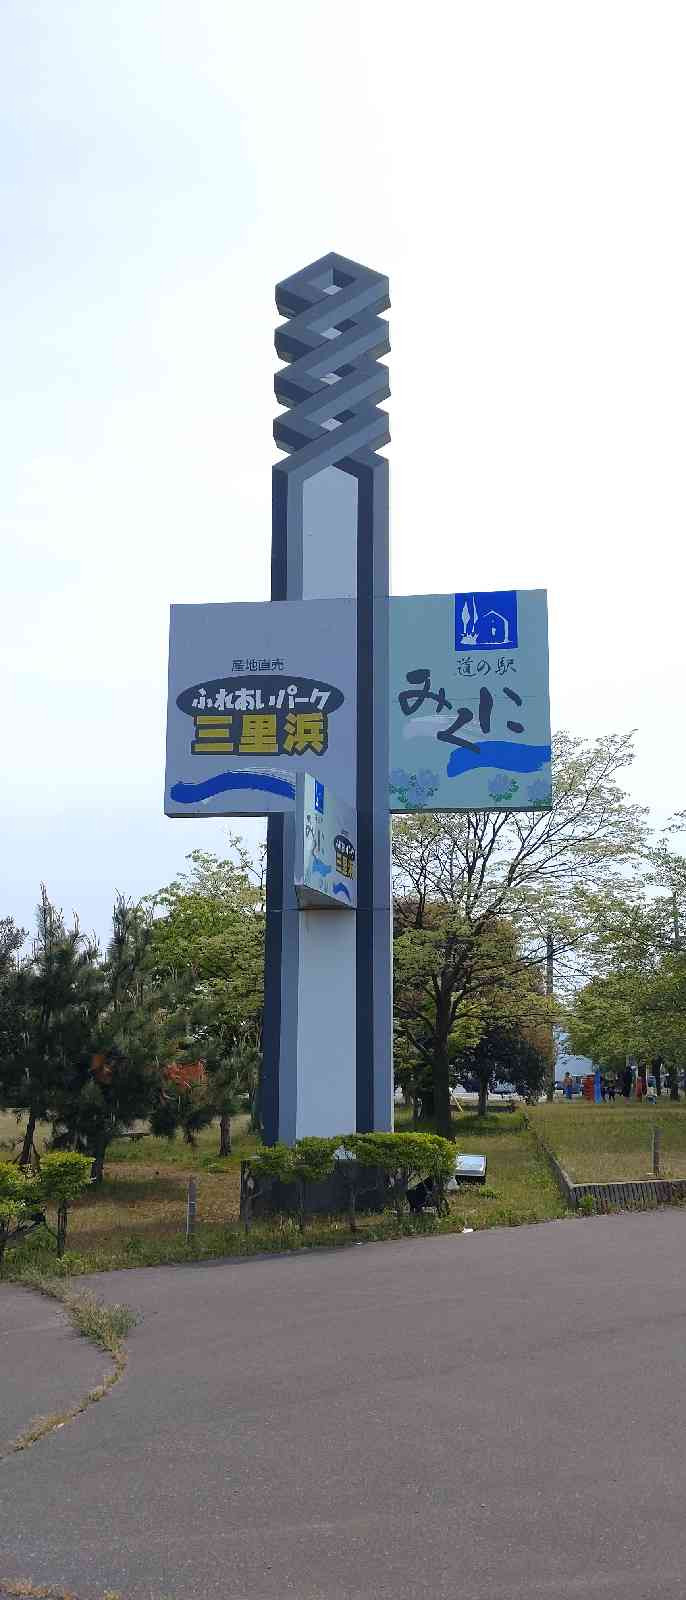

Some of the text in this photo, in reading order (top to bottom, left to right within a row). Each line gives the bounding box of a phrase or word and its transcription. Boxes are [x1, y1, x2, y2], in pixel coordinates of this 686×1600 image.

[231, 657, 285, 672] 産地直売
[456, 656, 517, 677] 道の駅
[191, 684, 332, 711] ふれあいパーク
[398, 668, 525, 755] みくに
[194, 712, 325, 754] 三里浜
